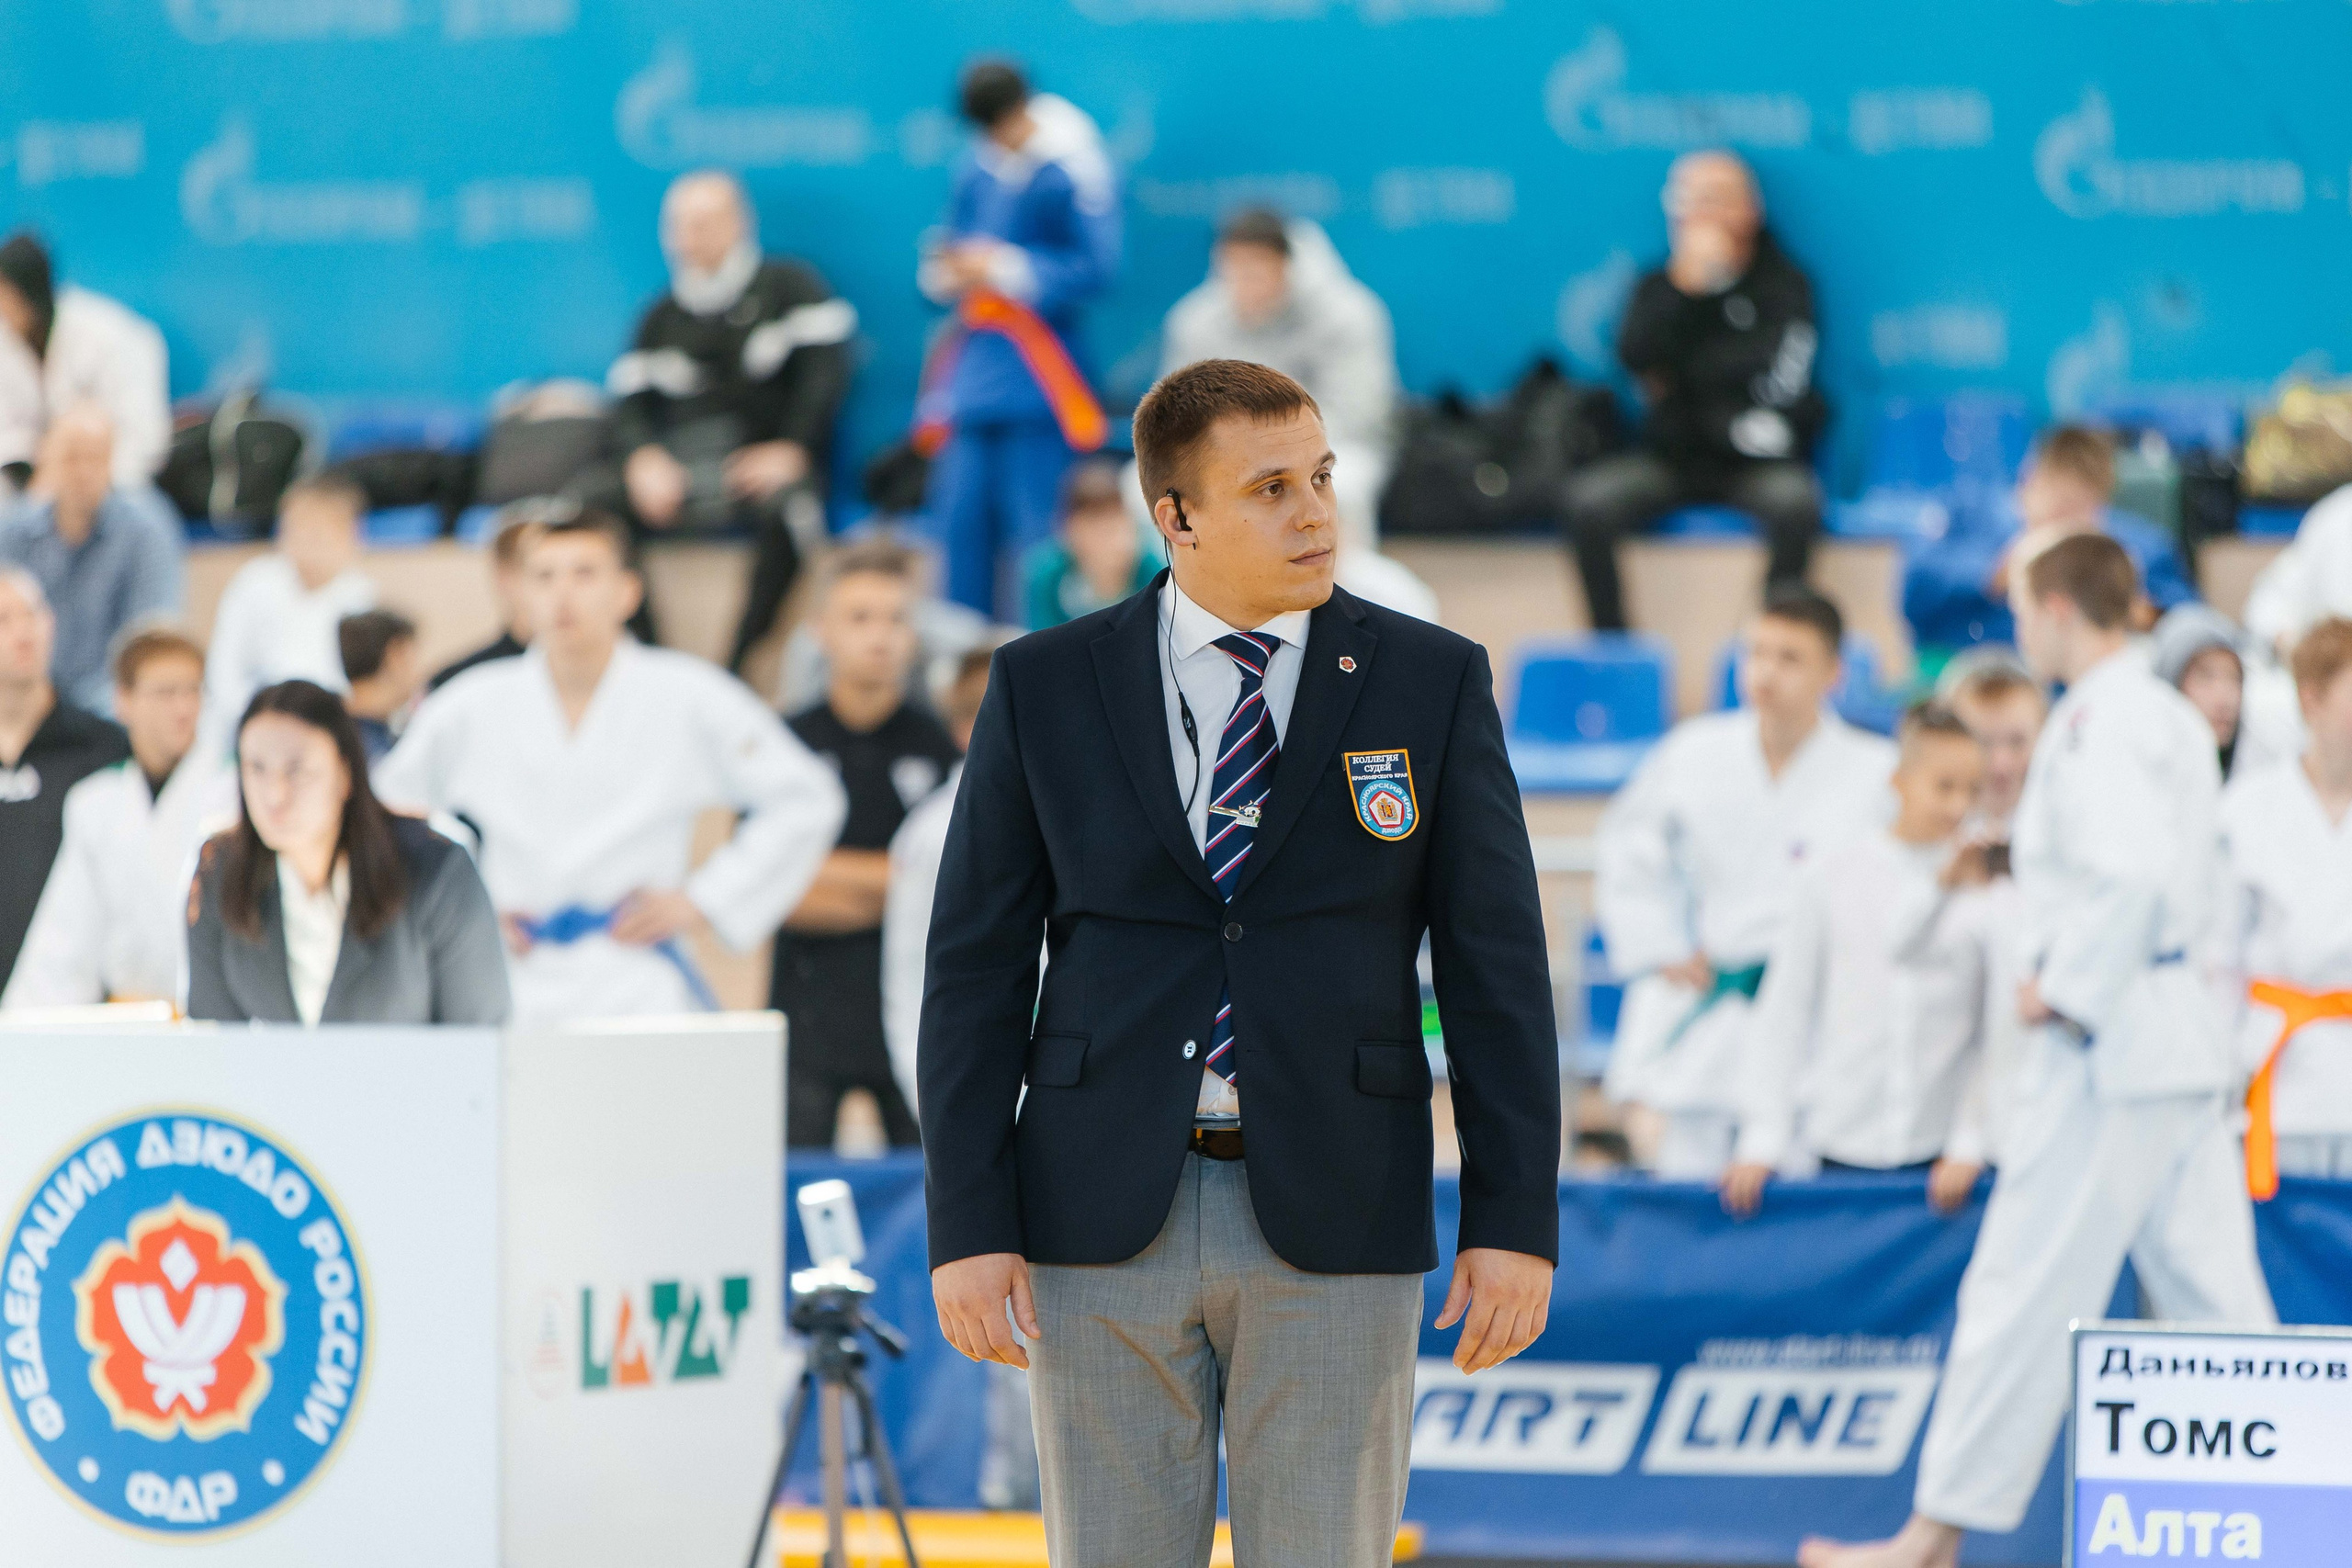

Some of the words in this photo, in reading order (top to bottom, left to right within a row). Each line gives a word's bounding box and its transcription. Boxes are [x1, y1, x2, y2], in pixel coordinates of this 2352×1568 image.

[1352, 754, 1399, 764] КОЛЛЕГИЯ
[1363, 761, 1392, 773] СУДЕЙ
[1361, 783, 1403, 822] КРАСНОЯРСКИЙ
[1401, 795, 1413, 820] КРАЙ
[5, 1136, 127, 1442] ФЕДЕРАЦИЯ
[135, 1119, 311, 1220] ДЗЮДО
[293, 1217, 359, 1447] РОССИИ
[2099, 1347, 2349, 1378] Даньялов
[1412, 1385, 1630, 1448] ART
[1681, 1388, 1898, 1450] LINE
[2095, 1401, 2278, 1459] Томс
[125, 1471, 238, 1524] ФДР
[2087, 1492, 2263, 1560] Алта
